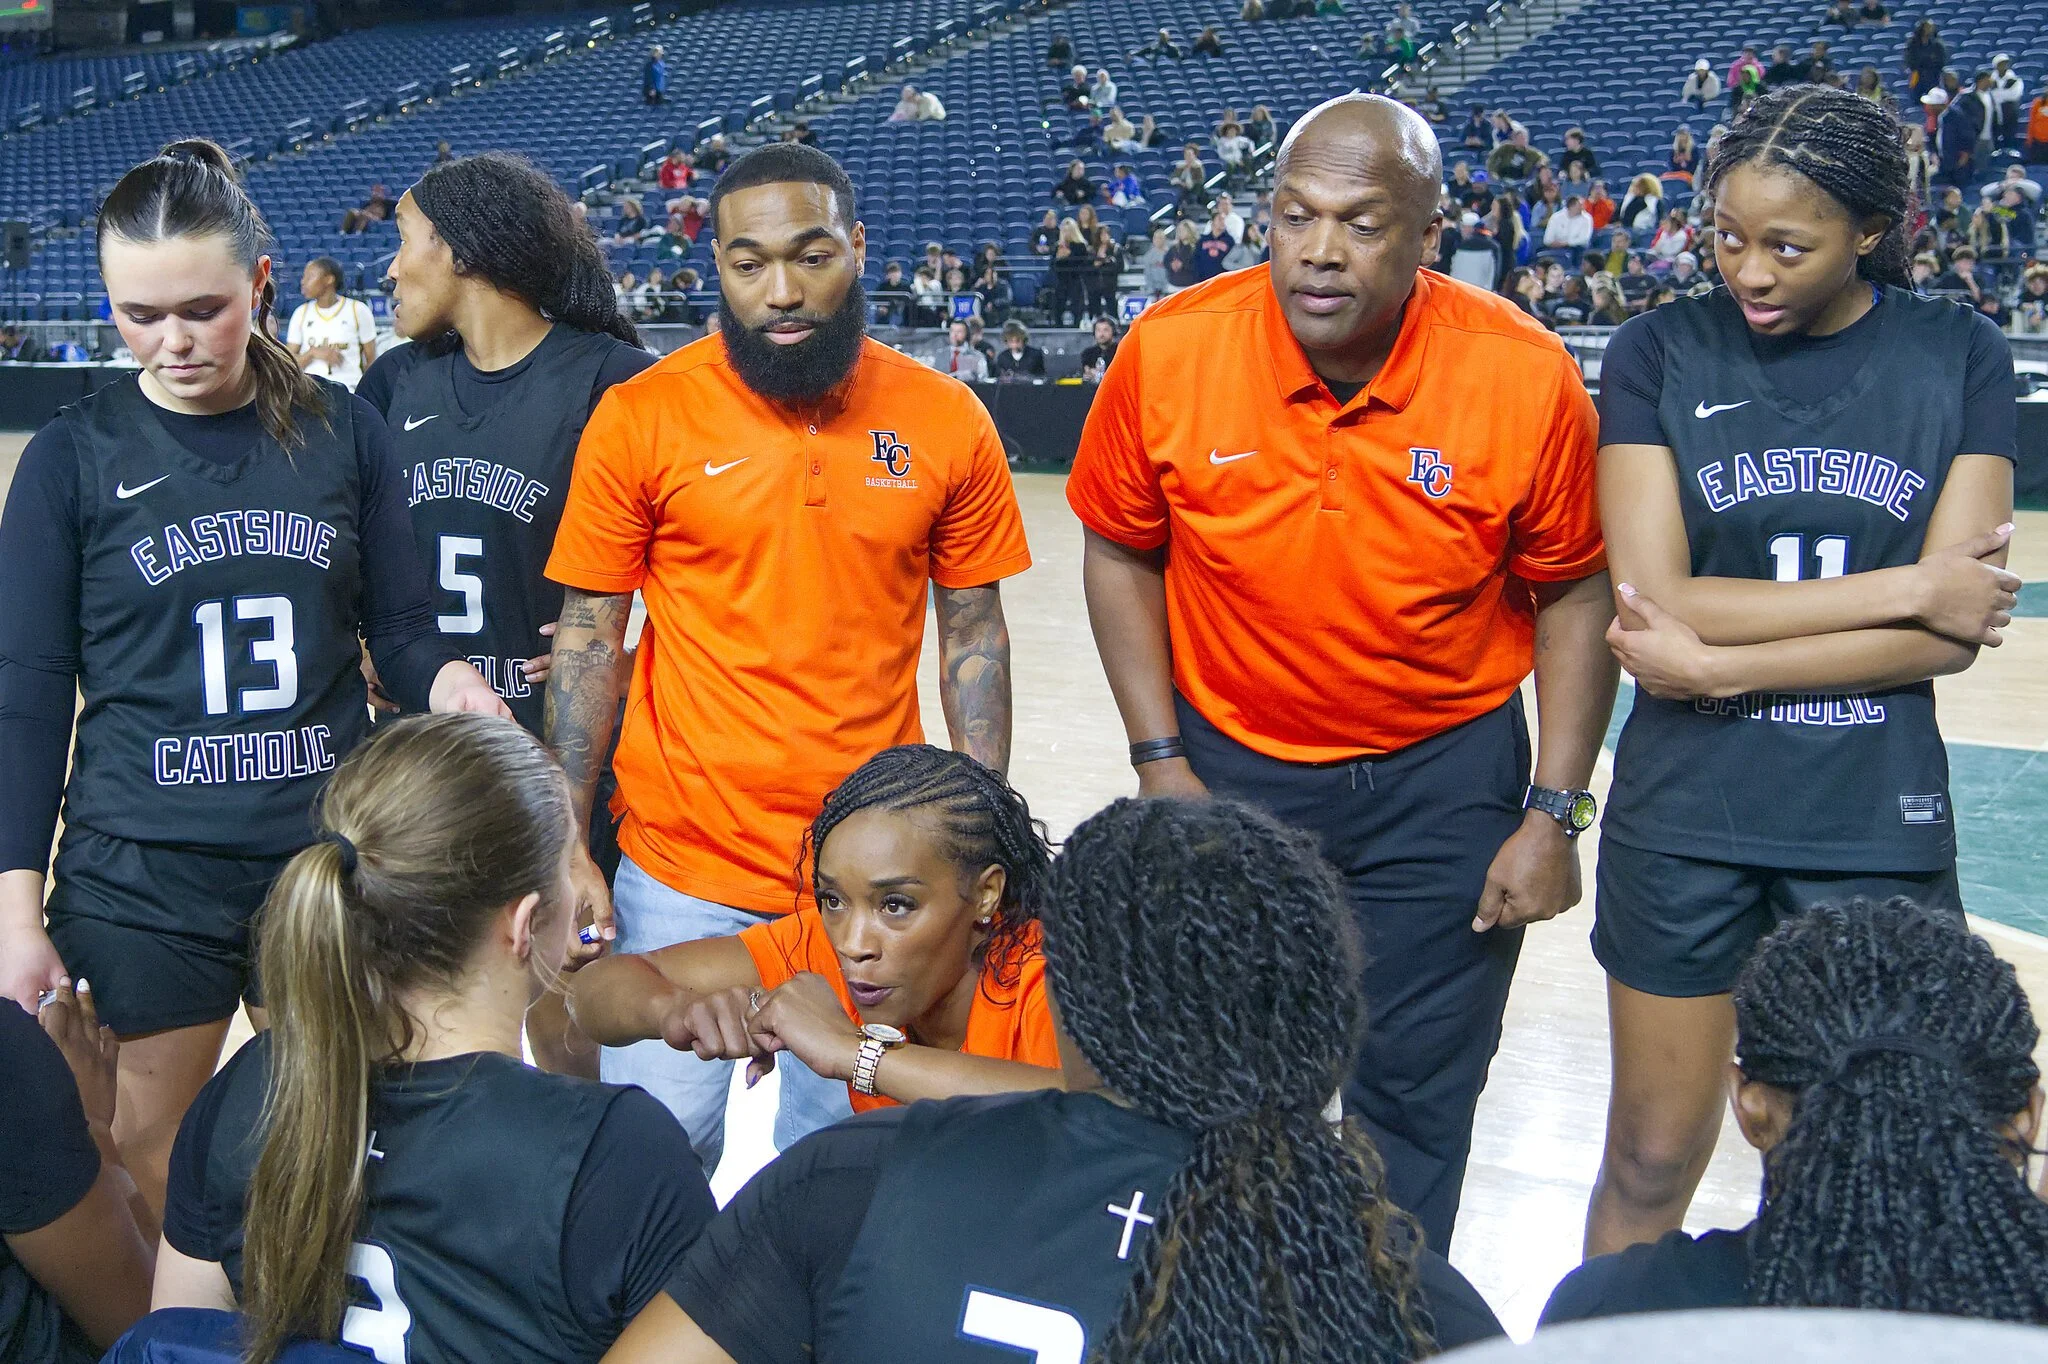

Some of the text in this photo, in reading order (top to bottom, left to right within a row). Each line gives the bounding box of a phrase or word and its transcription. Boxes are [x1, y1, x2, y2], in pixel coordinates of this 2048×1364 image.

[865, 477, 918, 489] BASKETBALL
[868, 430, 911, 478] EC
[1406, 447, 1453, 498] EC
[1697, 447, 1926, 522] EASTSIDE
[403, 457, 549, 524] ASTSIDE
[130, 509, 337, 586] EASTSIDE
[437, 533, 485, 635] 5
[192, 593, 299, 718] 13
[154, 724, 336, 786] CATHOLIC
